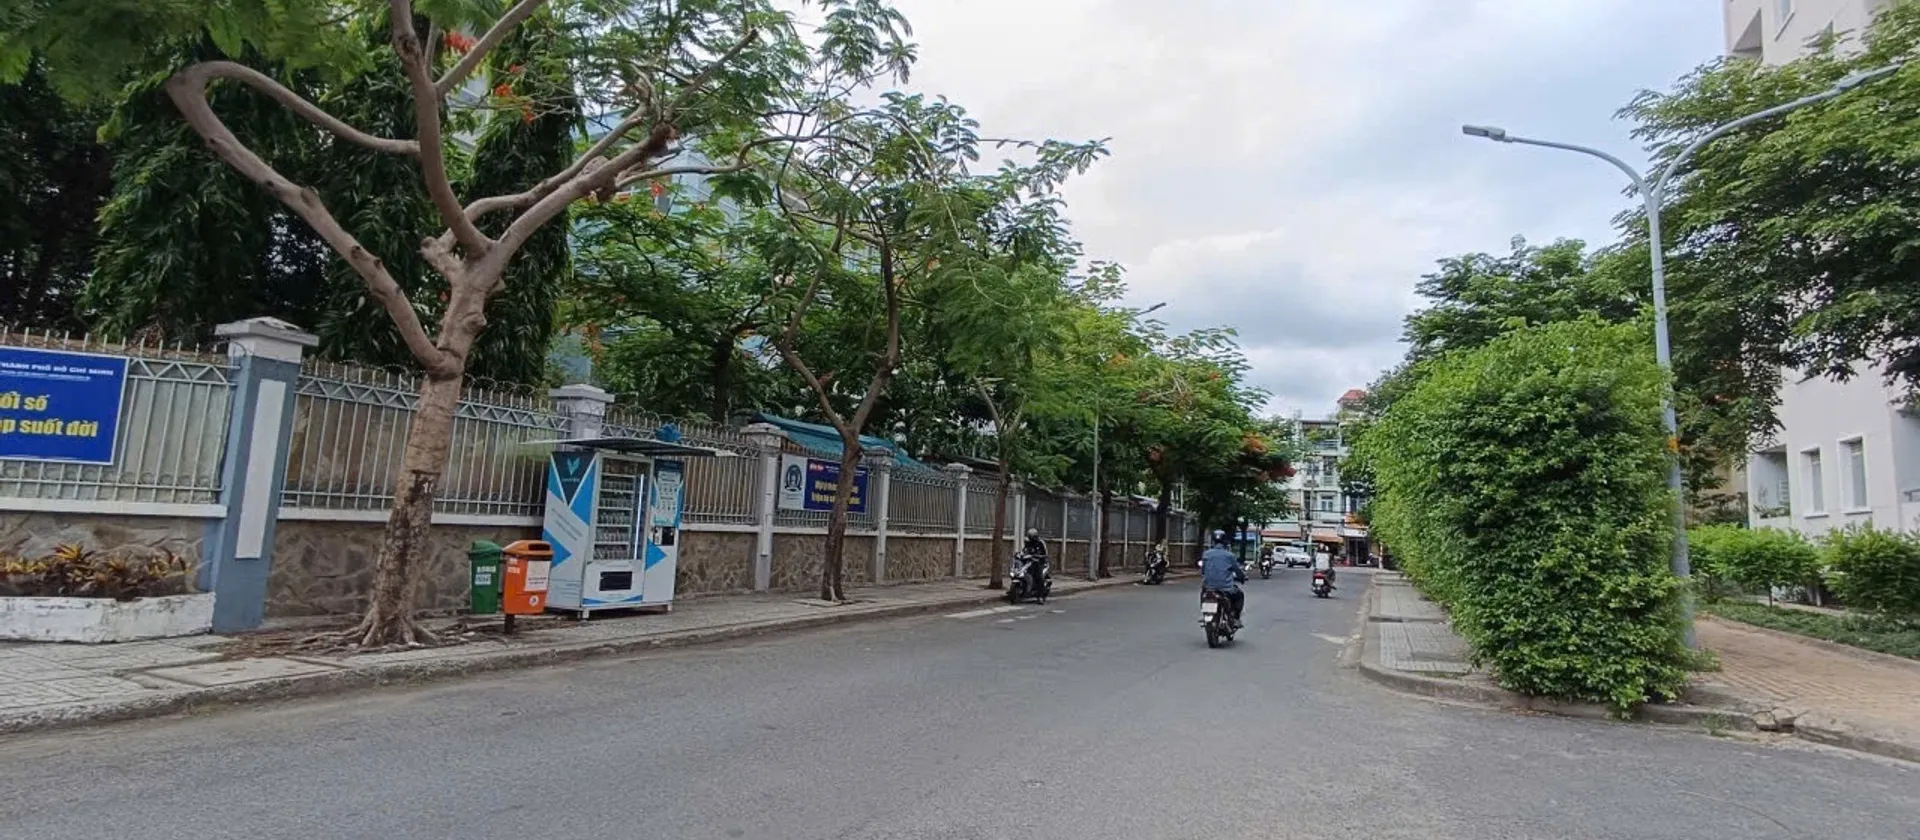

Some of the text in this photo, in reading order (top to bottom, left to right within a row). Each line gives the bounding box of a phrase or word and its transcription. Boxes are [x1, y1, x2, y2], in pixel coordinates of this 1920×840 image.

[24, 394, 50, 411] số
[20, 418, 64, 435] suốt
[66, 420, 98, 437] đời
